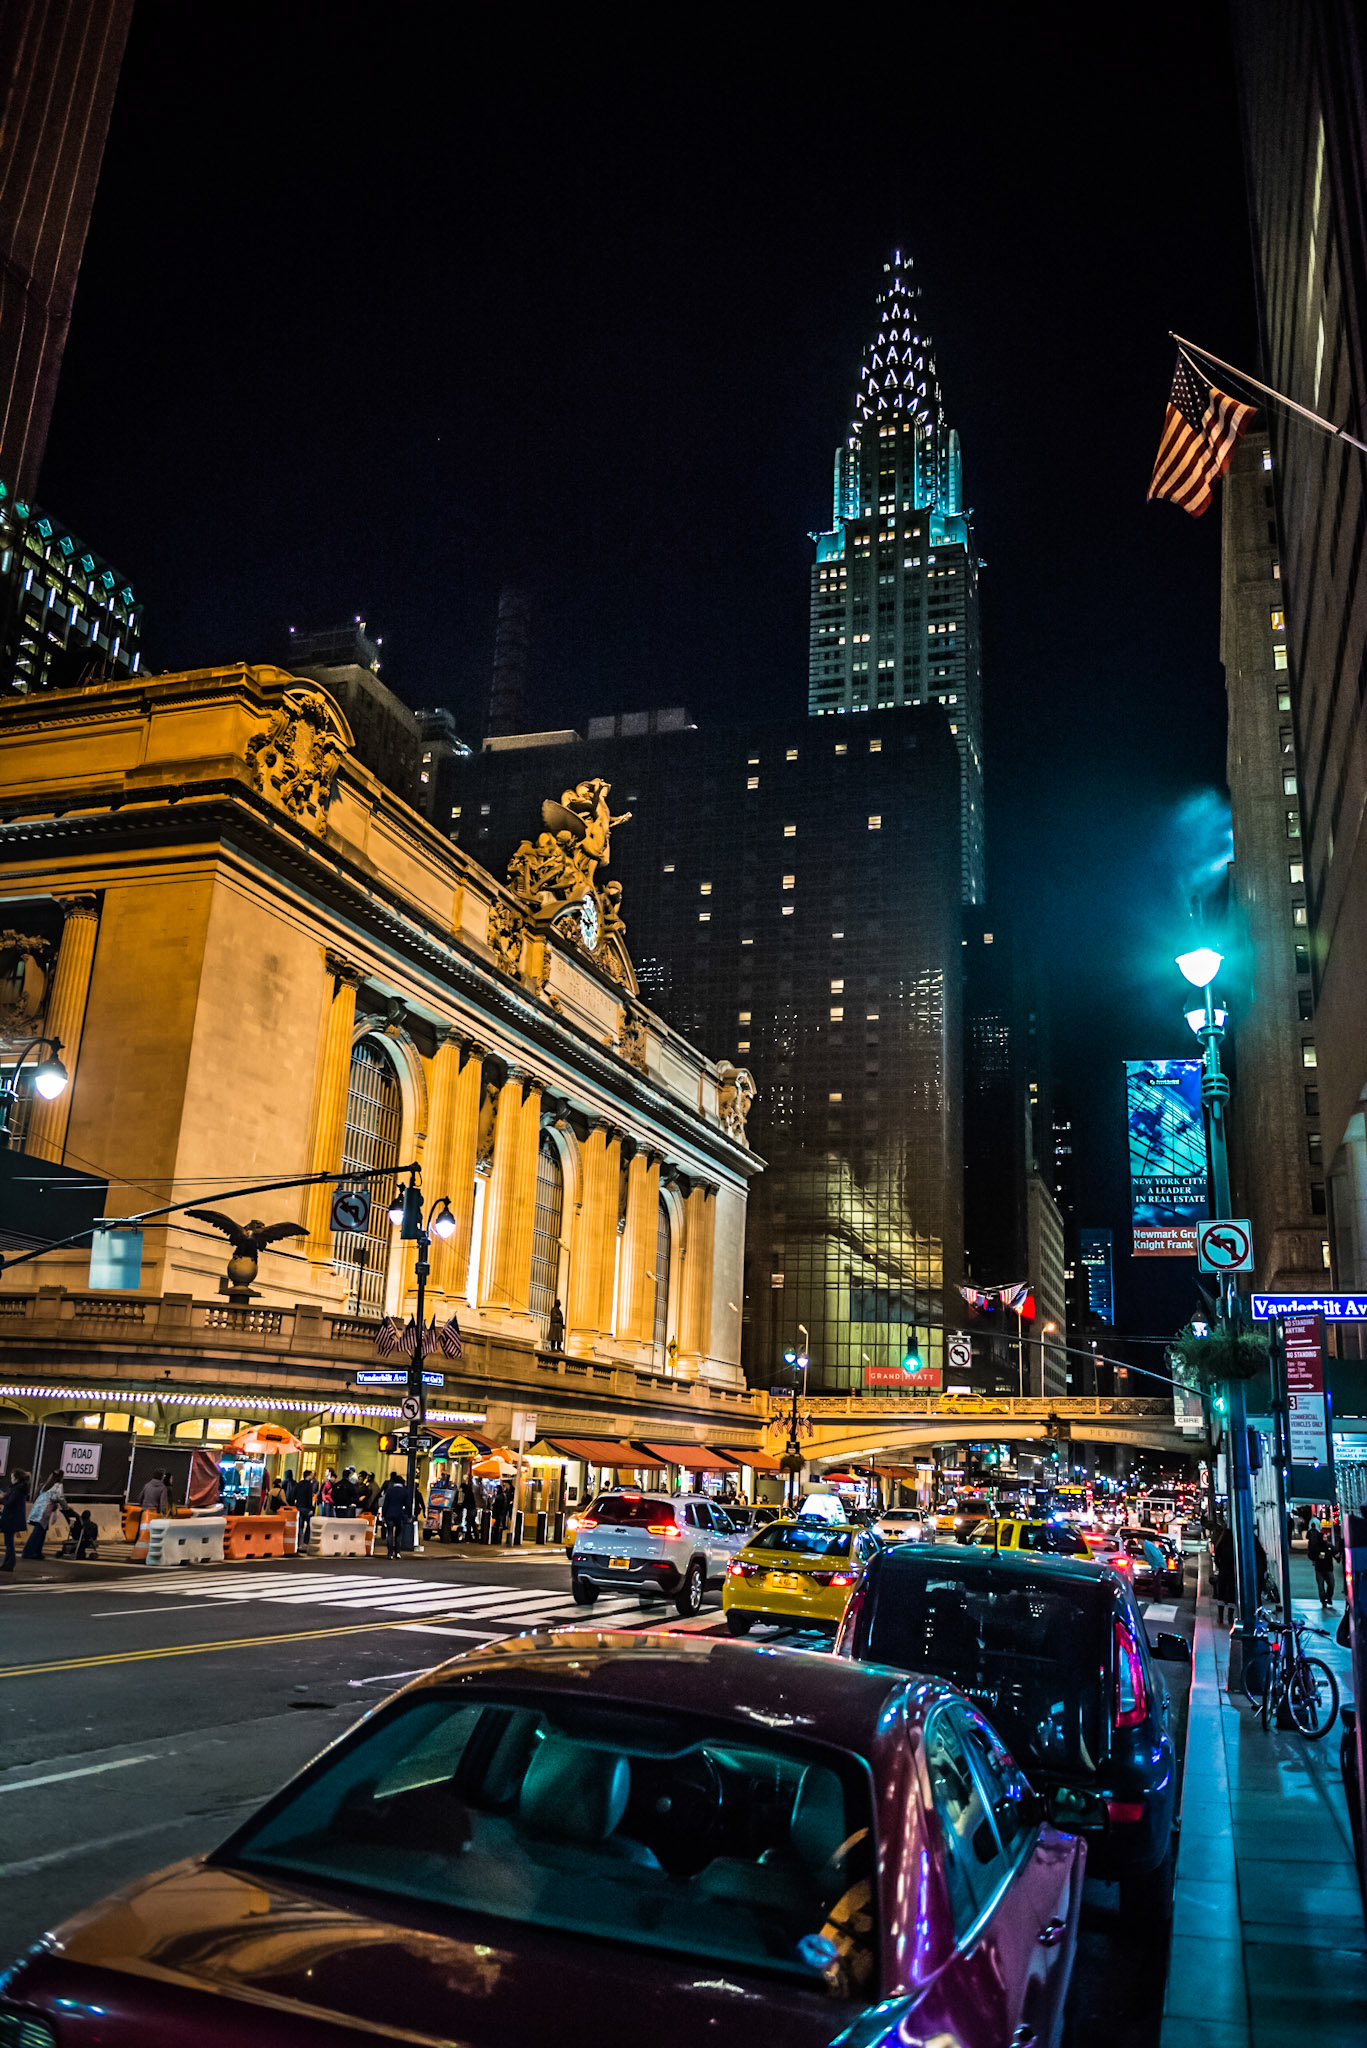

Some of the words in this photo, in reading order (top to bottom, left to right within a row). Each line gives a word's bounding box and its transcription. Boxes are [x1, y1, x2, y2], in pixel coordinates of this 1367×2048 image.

[1183, 1177, 1207, 1185] CITY:
[1147, 1187, 1154, 1195] A
[1156, 1187, 1192, 1195] LEADER
[1133, 1229, 1178, 1239] Newmark
[1133, 1240, 1165, 1251] Knight
[1167, 1240, 1194, 1249] Frank
[1255, 1300, 1341, 1315] Vanderbilt
[1292, 1318, 1315, 1327] STANDING
[905, 1373, 935, 1381] HYATT
[1289, 1396, 1296, 1410] 3
[72, 1447, 92, 1459] ROAD
[66, 1462, 94, 1474] CLOSED
